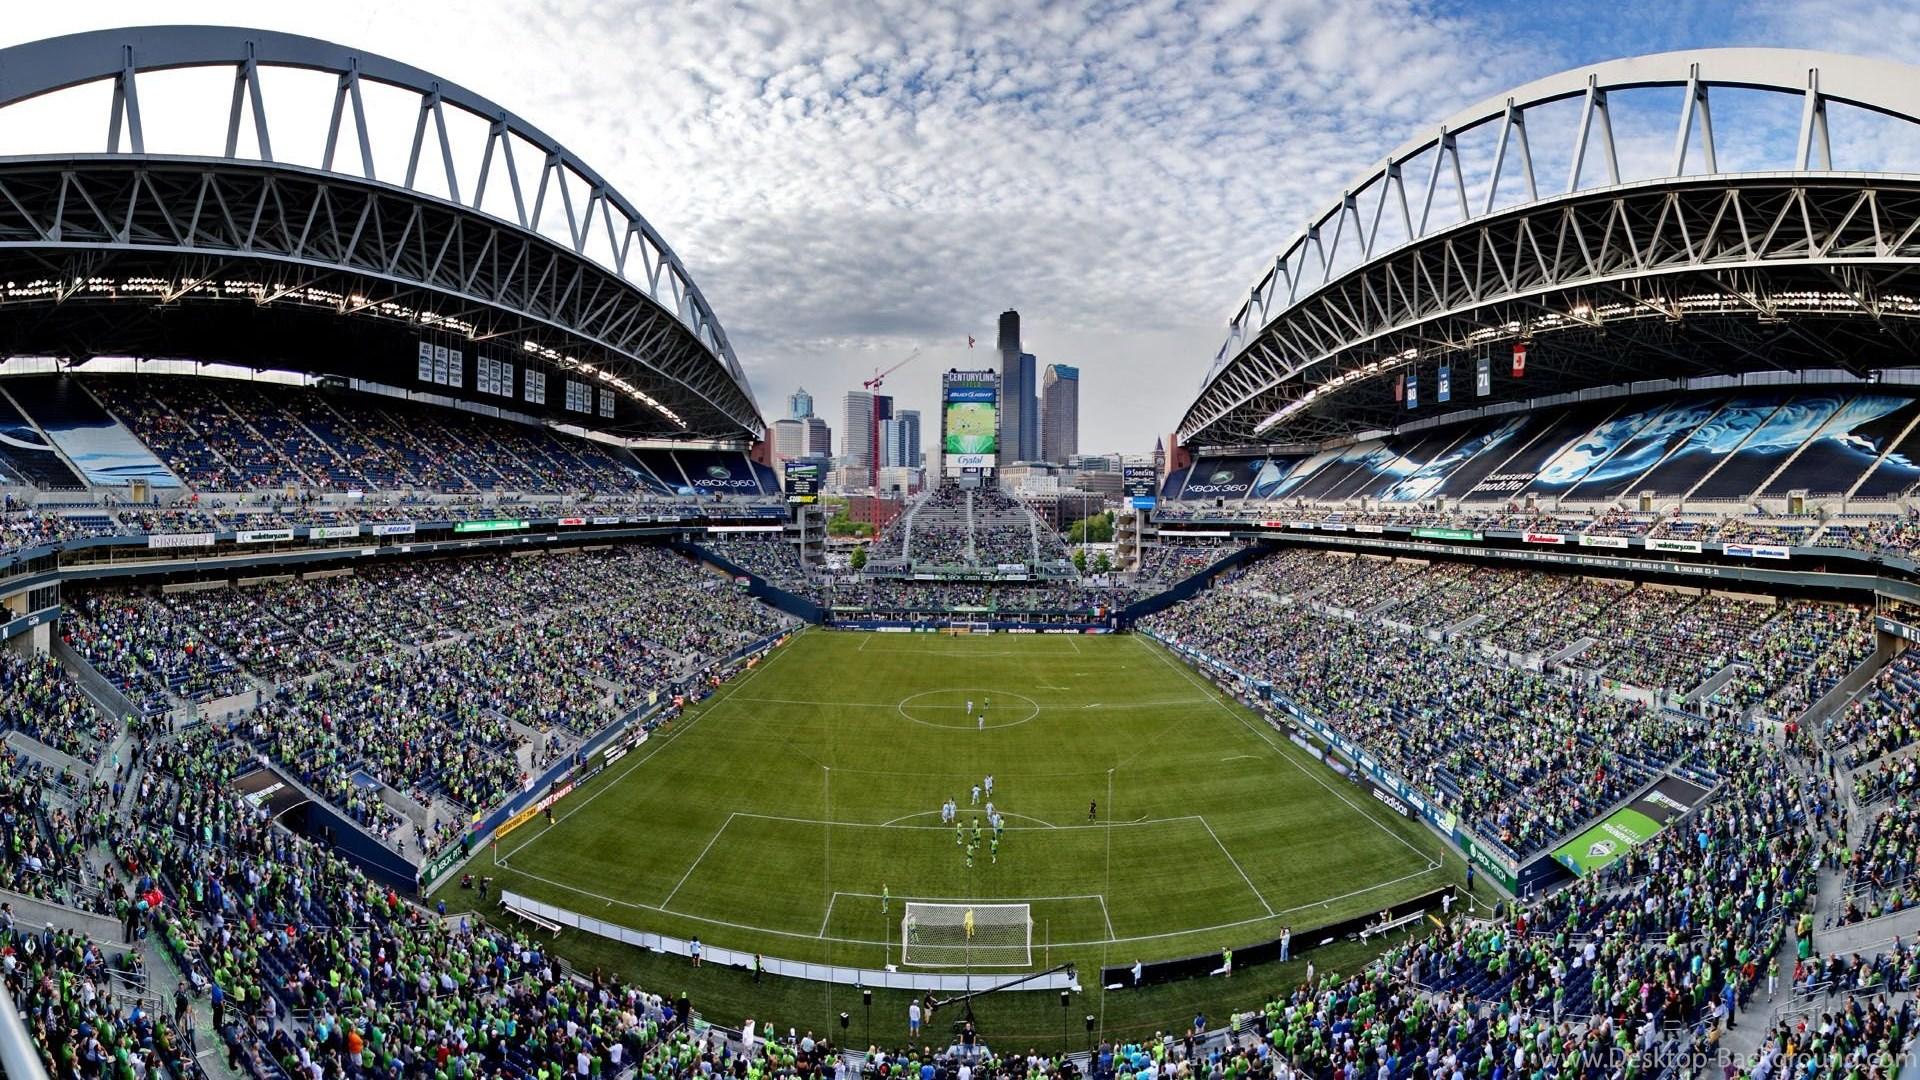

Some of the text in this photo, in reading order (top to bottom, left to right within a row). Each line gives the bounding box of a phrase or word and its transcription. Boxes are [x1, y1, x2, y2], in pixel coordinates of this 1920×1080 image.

[949, 372, 994, 382] CENTURYLINK
[1478, 373, 1489, 388] 71
[1407, 387, 1417, 401] 80
[1440, 380, 1449, 394] 12
[958, 455, 983, 466] Crystal
[692, 479, 757, 488] XBOX 360
[1487, 473, 1536, 481] SAMSUNG
[1186, 484, 1248, 492] XBOX 360
[1474, 480, 1524, 491] mobile
[537, 784, 573, 812] ROOT SPORTS
[1383, 795, 1408, 817] adidas
[438, 854, 452, 872] XBOX
[1477, 849, 1506, 883] XBOX PITCH
